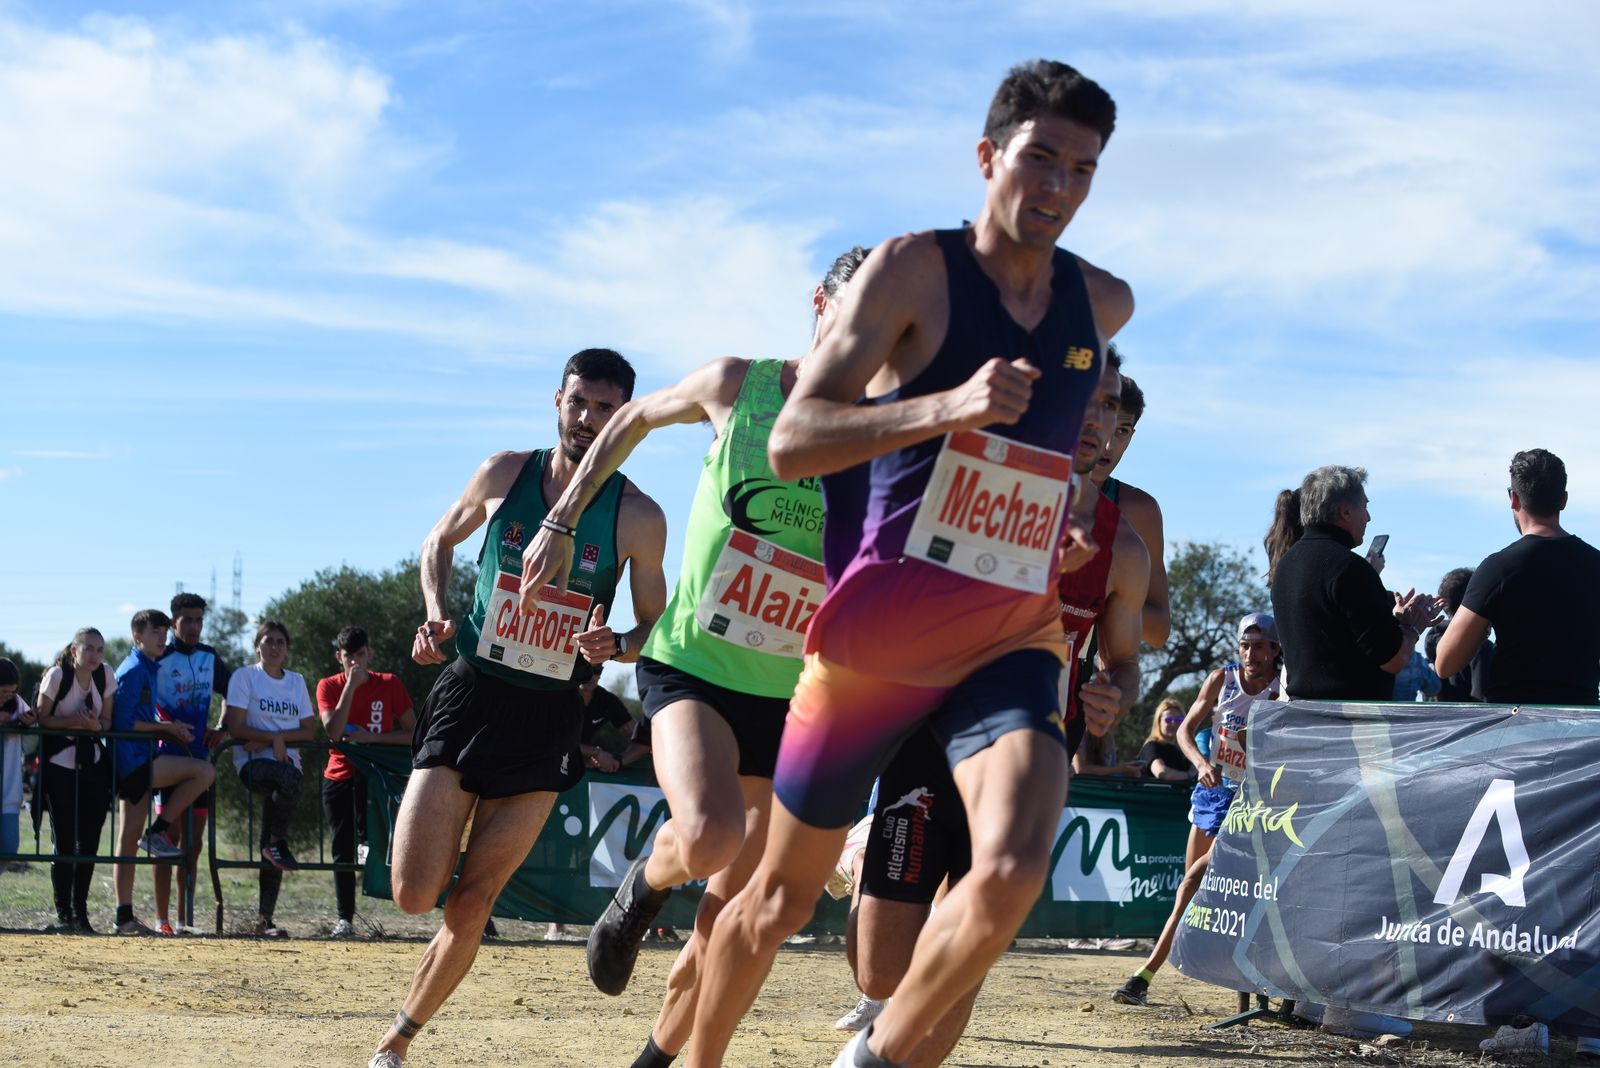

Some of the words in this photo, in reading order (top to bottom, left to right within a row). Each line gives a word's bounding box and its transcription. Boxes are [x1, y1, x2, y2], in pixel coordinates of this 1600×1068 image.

[938, 464, 1064, 551] Mechaal
[720, 563, 821, 635] Alaiz
[496, 598, 581, 655] CATROFE
[366, 700, 383, 734] das
[883, 815, 896, 839] Club
[887, 818, 909, 881] Atletismo
[1134, 853, 1147, 864] La
[1207, 868, 1249, 901] Europea
[1254, 873, 1279, 901] del
[1212, 907, 1246, 938] 2021
[1374, 916, 1430, 943] Junta
[1437, 918, 1465, 946] de
